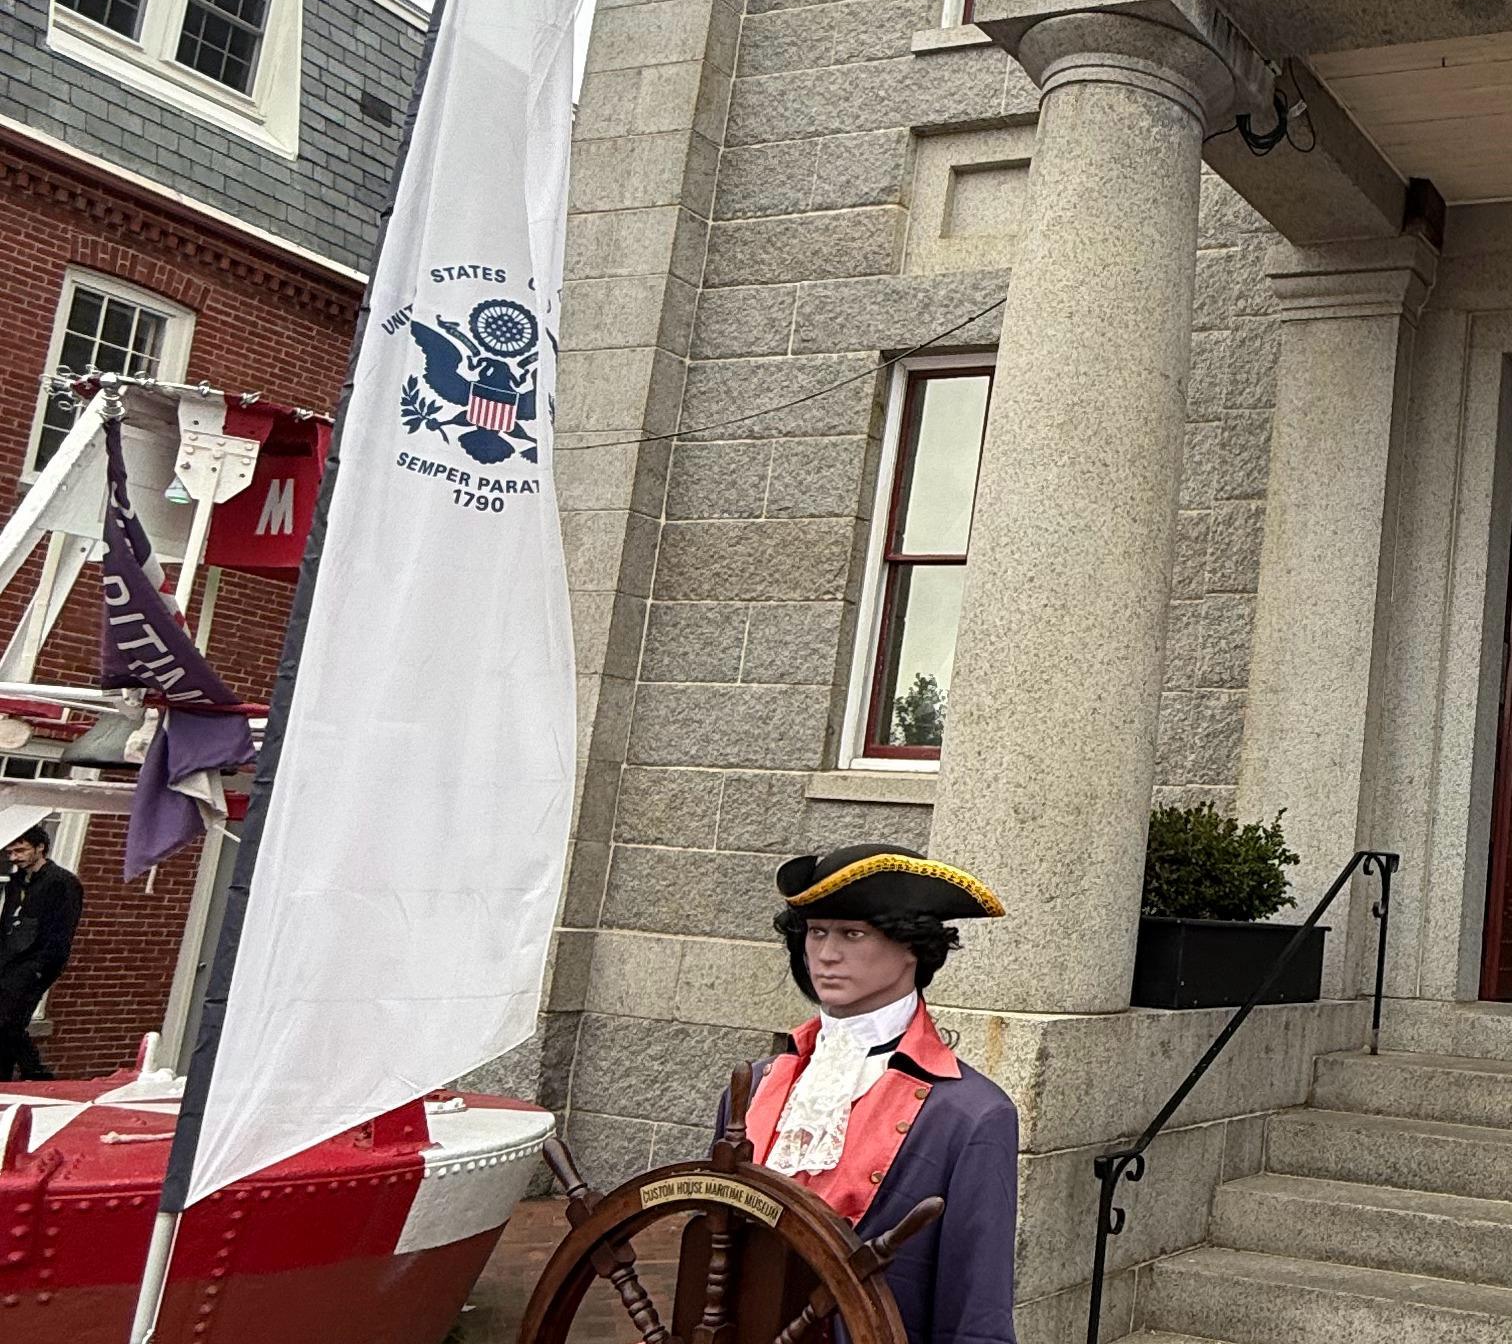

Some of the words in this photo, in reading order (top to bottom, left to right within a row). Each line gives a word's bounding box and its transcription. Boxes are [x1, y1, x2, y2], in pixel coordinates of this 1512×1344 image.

[381, 303, 413, 335] UNIT
[430, 265, 507, 283] STATES
[396, 452, 471, 487] SEMPER
[477, 478, 540, 494] PARAT
[255, 478, 295, 535] M
[452, 490, 505, 513] 1790
[642, 1183, 675, 1204] CUSTOM
[676, 1181, 704, 1195] HOUSE
[705, 1182, 744, 1203] MARITIME
[744, 1193, 779, 1220] MUSEUM
